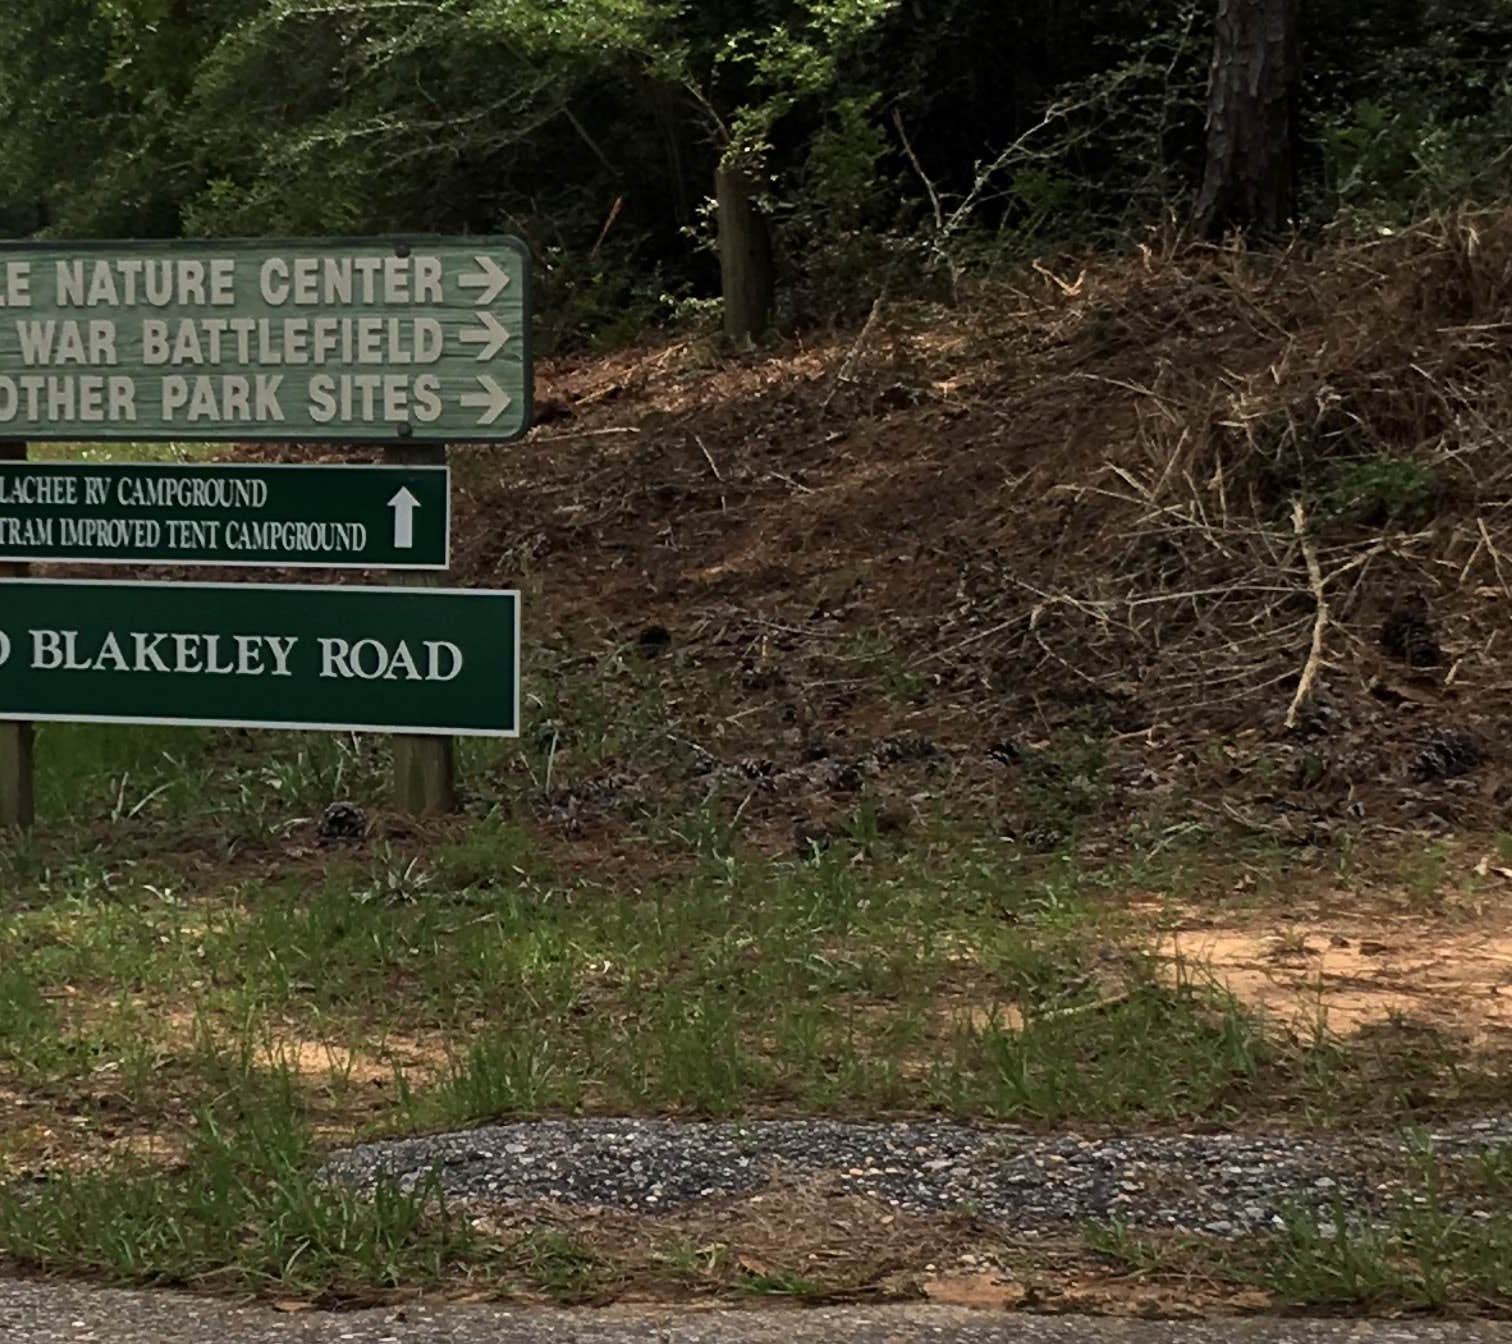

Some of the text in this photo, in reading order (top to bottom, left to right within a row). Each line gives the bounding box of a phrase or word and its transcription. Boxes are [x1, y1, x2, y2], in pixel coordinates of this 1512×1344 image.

[56, 260, 234, 306] NATURE
[260, 256, 443, 305] CENTER
[16, 320, 117, 366] WAR
[142, 318, 443, 365] BATTLEFIELD
[162, 375, 285, 421] PARK
[309, 374, 441, 422] SITES
[85, 477, 110, 505] RV
[118, 478, 267, 508] CAMPGROUND
[60, 518, 160, 548] IMPROVED
[166, 521, 219, 549] TENT
[225, 522, 366, 552] CAMPGROUND
[29, 630, 298, 676] BLAKELEY
[319, 637, 463, 681] ROAD
